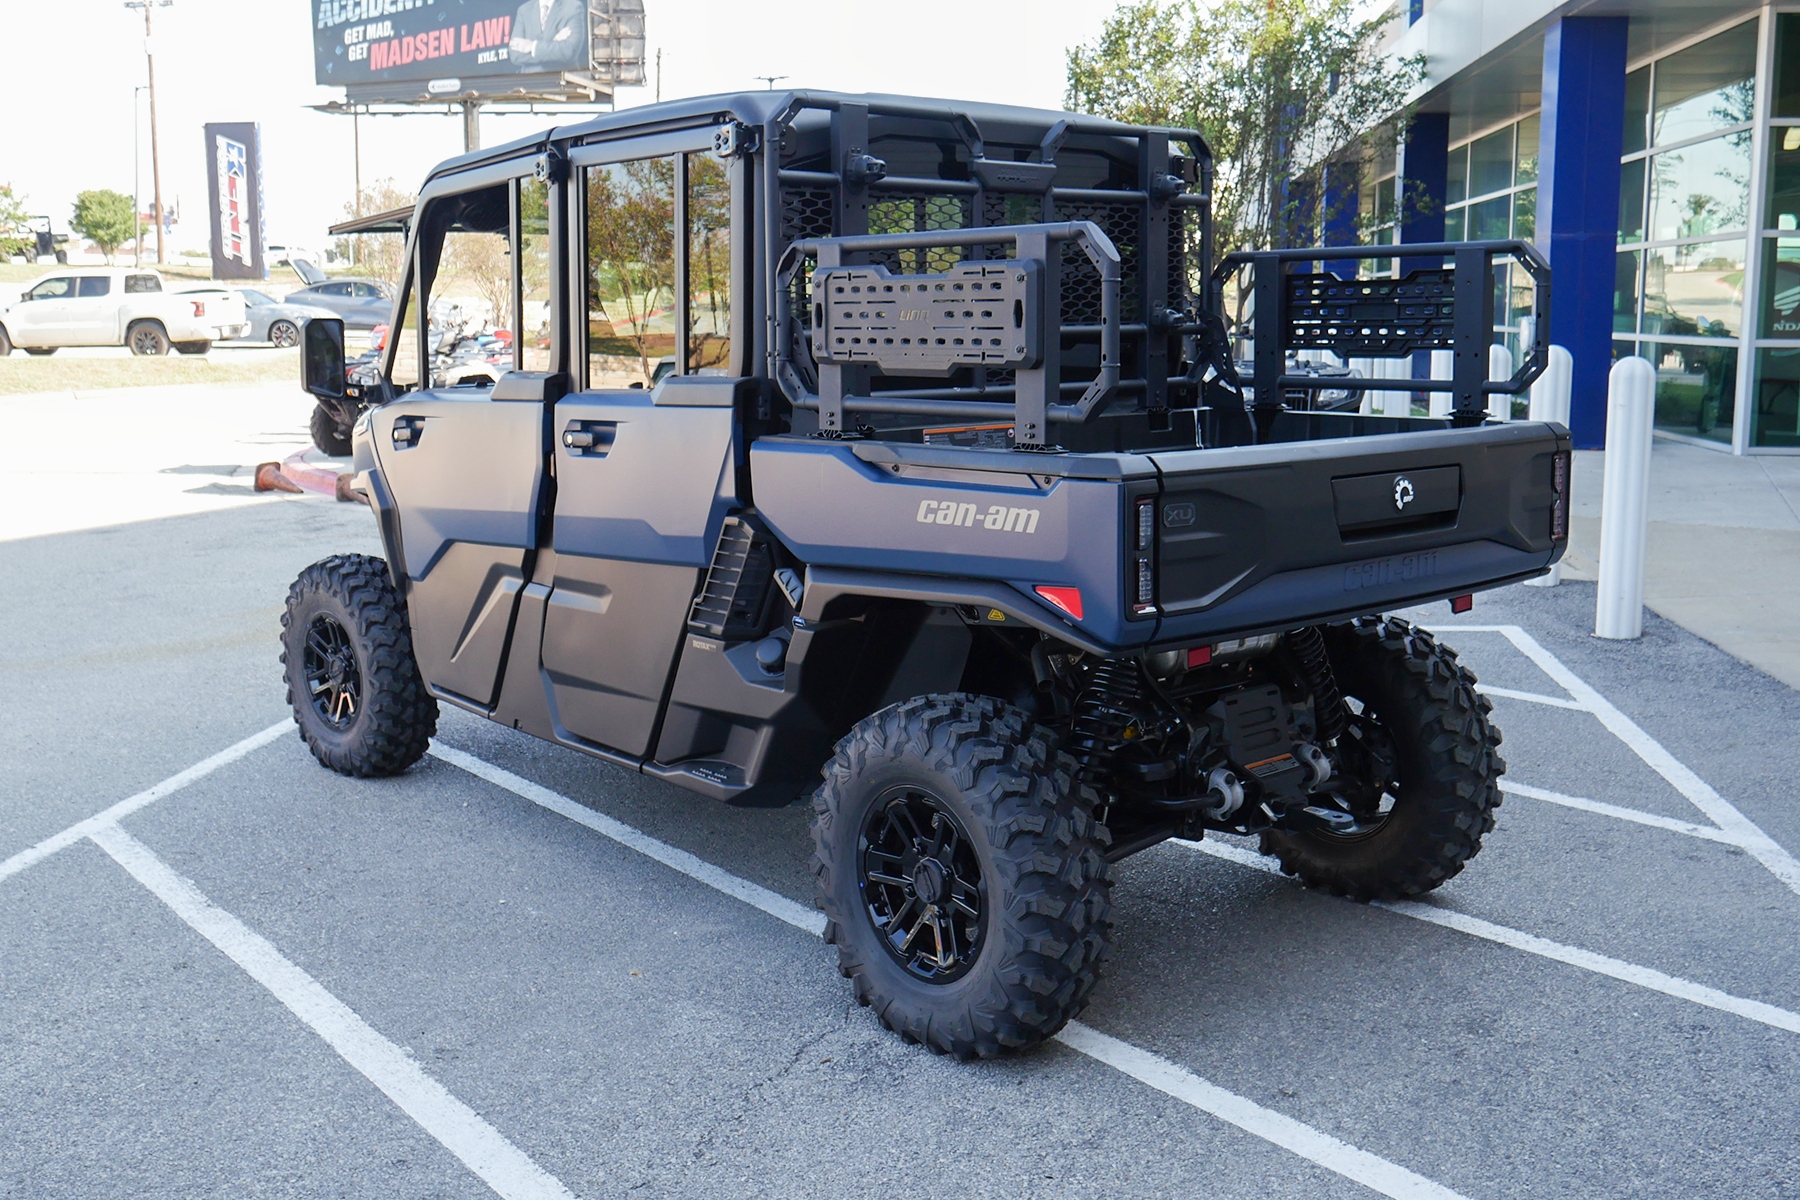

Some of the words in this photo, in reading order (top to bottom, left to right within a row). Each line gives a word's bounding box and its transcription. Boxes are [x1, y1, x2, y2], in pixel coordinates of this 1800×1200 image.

[344, 25, 365, 45] GET
[366, 20, 395, 40] MAD,
[348, 42, 369, 62] GET
[370, 27, 456, 71] MADSEN
[460, 15, 511, 52] LAW!
[477, 50, 497, 65] KYLE,
[498, 48, 508, 61] TX
[916, 499, 1040, 534] can-am
